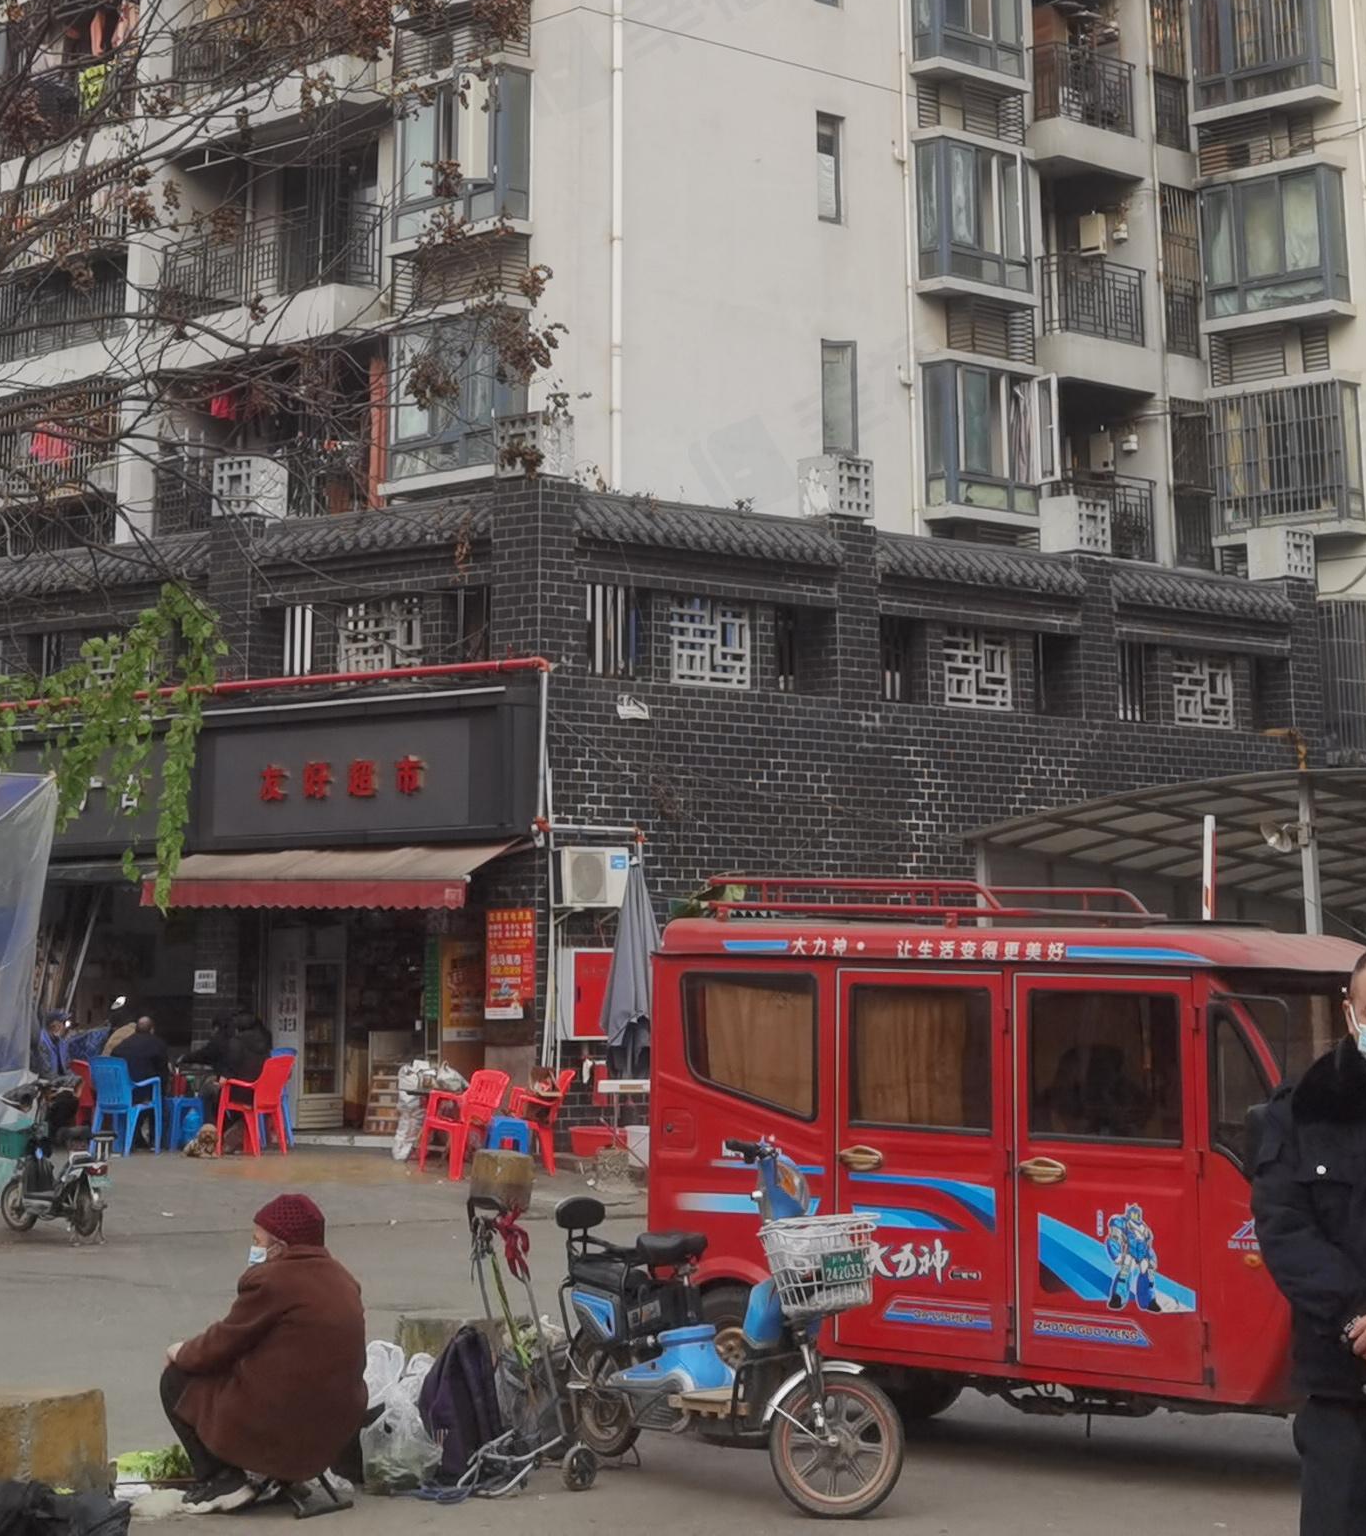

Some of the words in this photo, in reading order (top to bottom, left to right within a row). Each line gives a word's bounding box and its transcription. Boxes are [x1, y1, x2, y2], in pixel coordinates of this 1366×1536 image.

[259, 755, 427, 802] 友好超市
[896, 940, 1066, 961] 让生活变得更美好
[825, 1263, 864, 1283] 242033
[865, 1238, 951, 1284] 大力神
